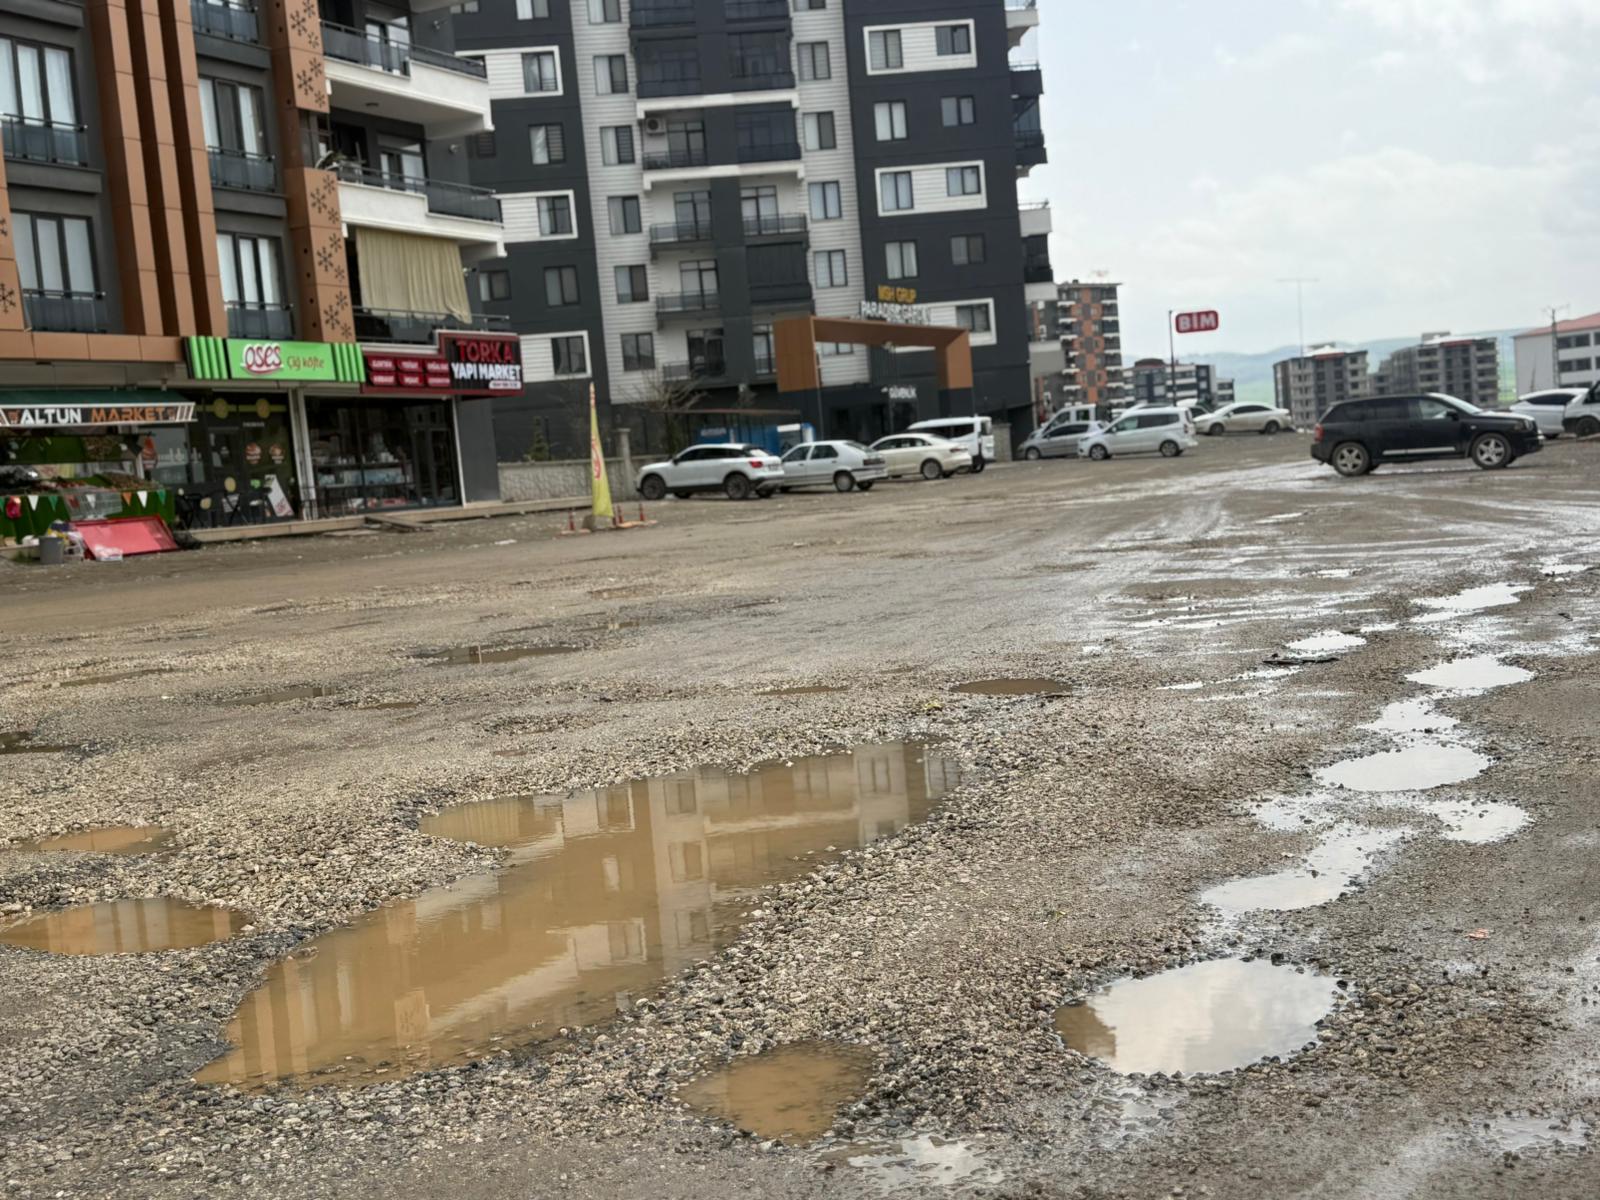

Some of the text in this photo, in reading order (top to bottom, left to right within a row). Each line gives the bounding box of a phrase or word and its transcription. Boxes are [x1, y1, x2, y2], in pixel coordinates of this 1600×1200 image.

[1178, 312, 1216, 330] BİM
[456, 338, 514, 362] TORKA
[451, 362, 477, 379] YAPI
[478, 364, 521, 380] MARKET
[20, 406, 165, 424] ALTUN MARKET
